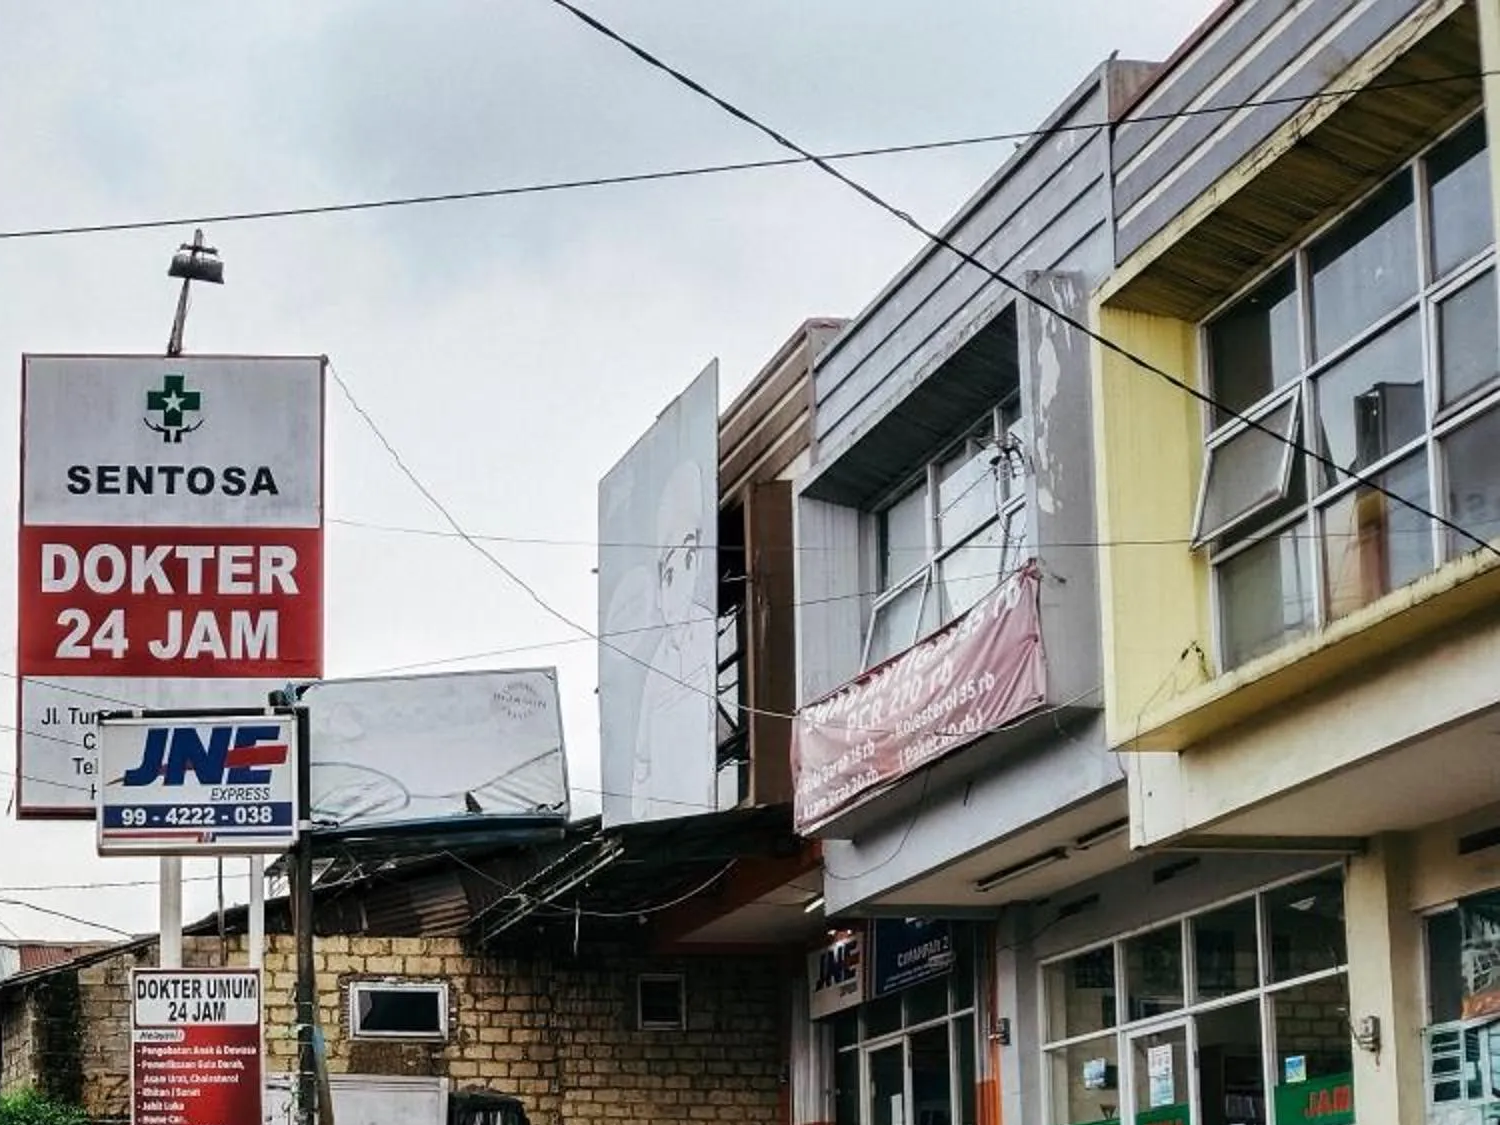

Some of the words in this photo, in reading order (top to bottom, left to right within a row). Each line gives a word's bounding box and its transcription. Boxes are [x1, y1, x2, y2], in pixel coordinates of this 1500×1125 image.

[67, 465, 279, 497] SENTOSA
[41, 543, 299, 596] DOKTER
[55, 609, 129, 660] 24
[149, 609, 279, 661] JAM
[41, 707, 61, 725] Jl.
[122, 725, 289, 787] JNE
[210, 787, 271, 801] EXPRESS
[121, 808, 147, 826] 99
[165, 807, 216, 825] 4222
[234, 806, 273, 824] 038
[815, 940, 858, 992] JNE
[137, 979, 202, 1000] DOKTER
[206, 979, 257, 1000] UMUM
[168, 1002, 187, 1021] 24
[192, 1002, 227, 1022] JAM
